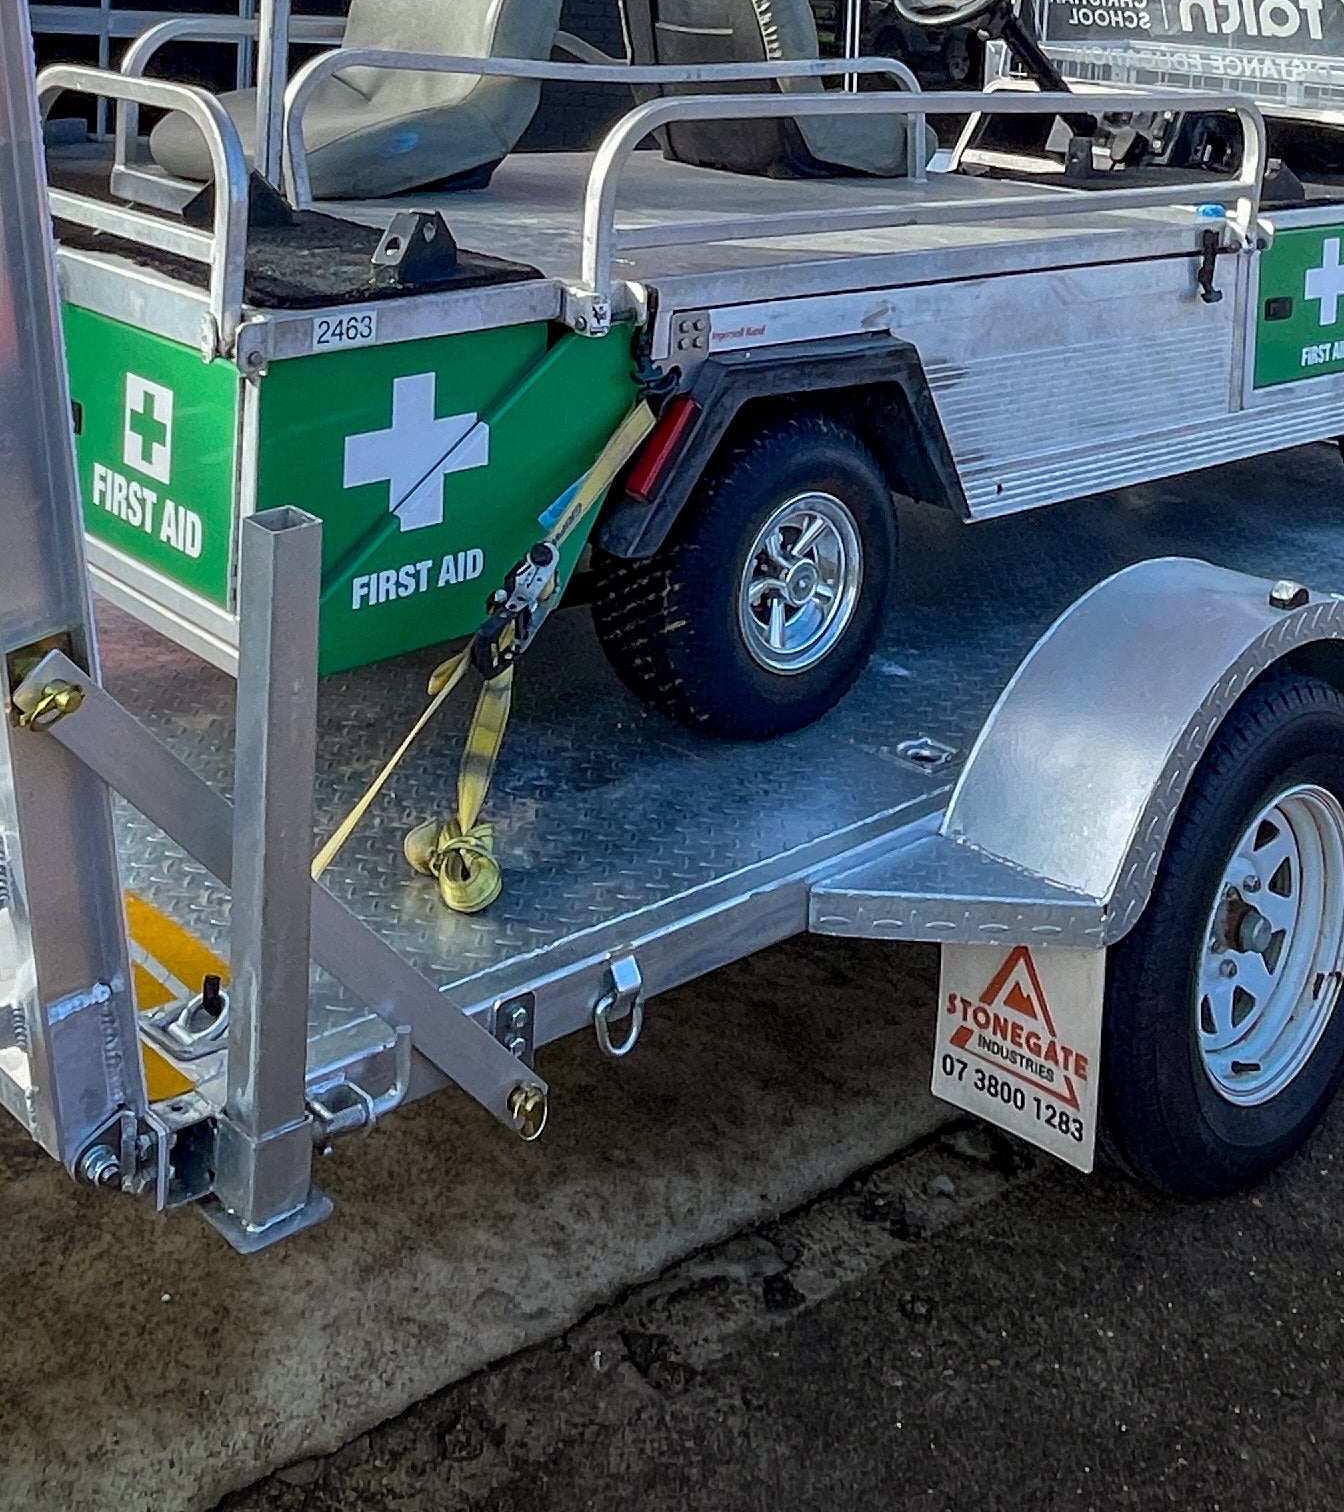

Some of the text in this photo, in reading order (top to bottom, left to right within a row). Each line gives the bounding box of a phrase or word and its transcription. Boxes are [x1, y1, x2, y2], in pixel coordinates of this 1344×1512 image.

[317, 315, 372, 344] 2463
[1301, 343, 1331, 366] FIRST
[92, 462, 203, 560] FIRST AID
[351, 547, 485, 611] FIRST AID
[946, 992, 1089, 1082] STONEGATE
[977, 1033, 1055, 1084] INDUSTRIES
[942, 1053, 1085, 1143] 07 3800 1283
